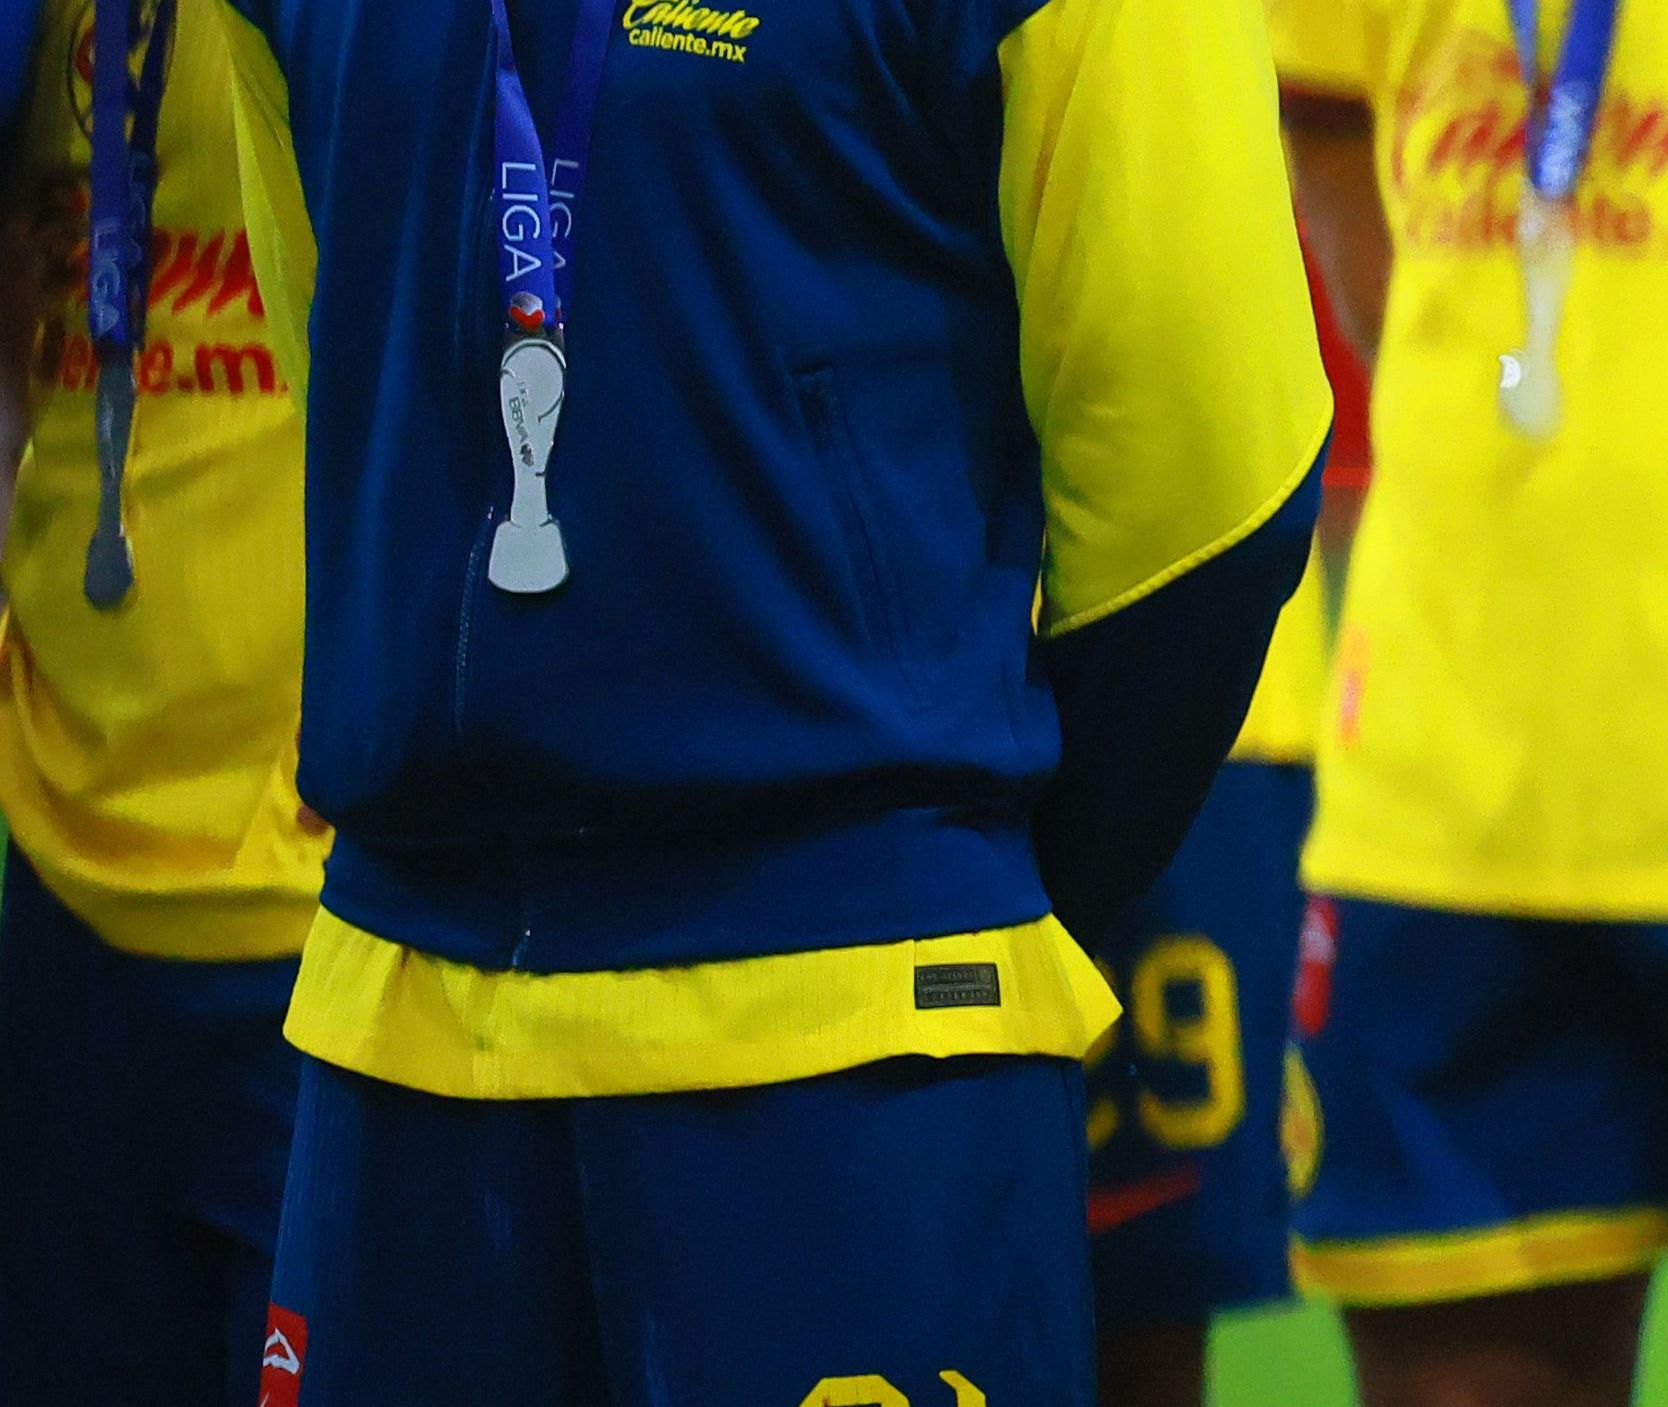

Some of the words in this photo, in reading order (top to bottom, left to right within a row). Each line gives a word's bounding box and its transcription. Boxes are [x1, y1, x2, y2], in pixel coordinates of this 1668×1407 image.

[628, 26, 747, 63] caliente.mx
[502, 162, 542, 282] LIGA
[1085, 932, 1248, 1150] 9
